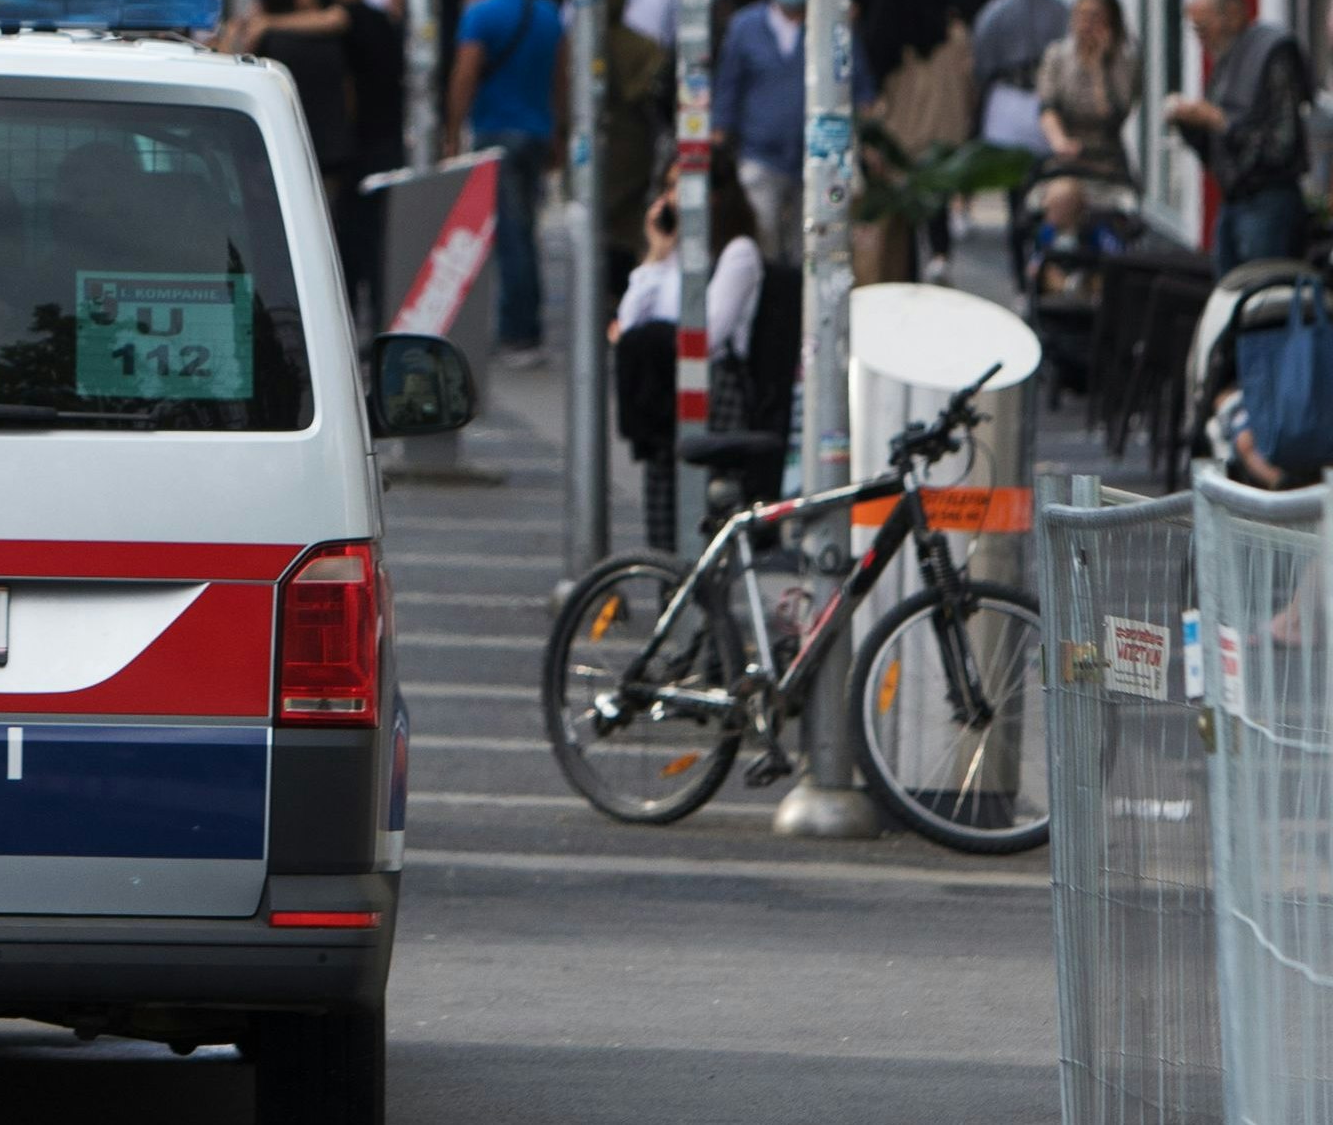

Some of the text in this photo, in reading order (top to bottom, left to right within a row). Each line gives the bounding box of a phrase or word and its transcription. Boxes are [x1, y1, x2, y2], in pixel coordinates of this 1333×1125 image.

[135, 288, 218, 301] KOMPANIE
[136, 307, 184, 337] U
[111, 343, 212, 379] 112
